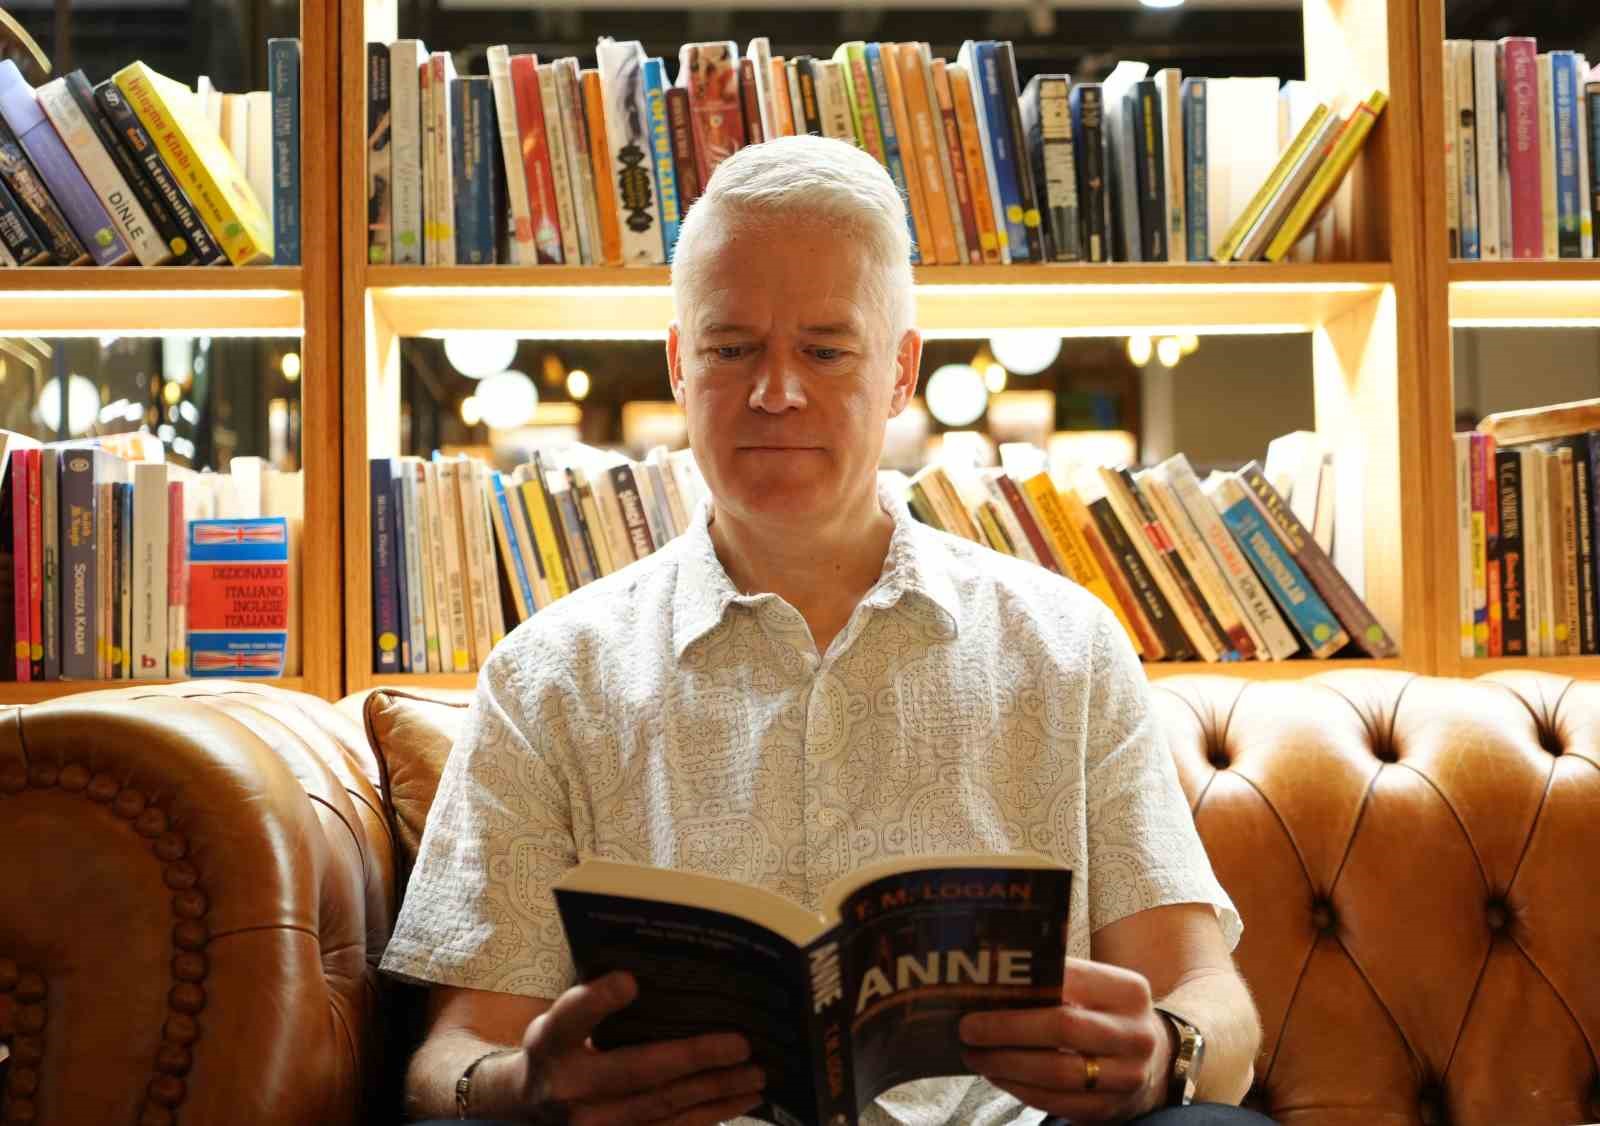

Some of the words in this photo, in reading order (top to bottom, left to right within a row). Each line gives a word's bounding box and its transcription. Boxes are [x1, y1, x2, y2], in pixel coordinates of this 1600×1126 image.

[225, 586, 284, 599] ITALIANO
[224, 614, 284, 628] ITALIANO
[923, 880, 1033, 899] LOGAN
[808, 941, 844, 1015] ANNE
[855, 949, 1033, 1015] ANNE
